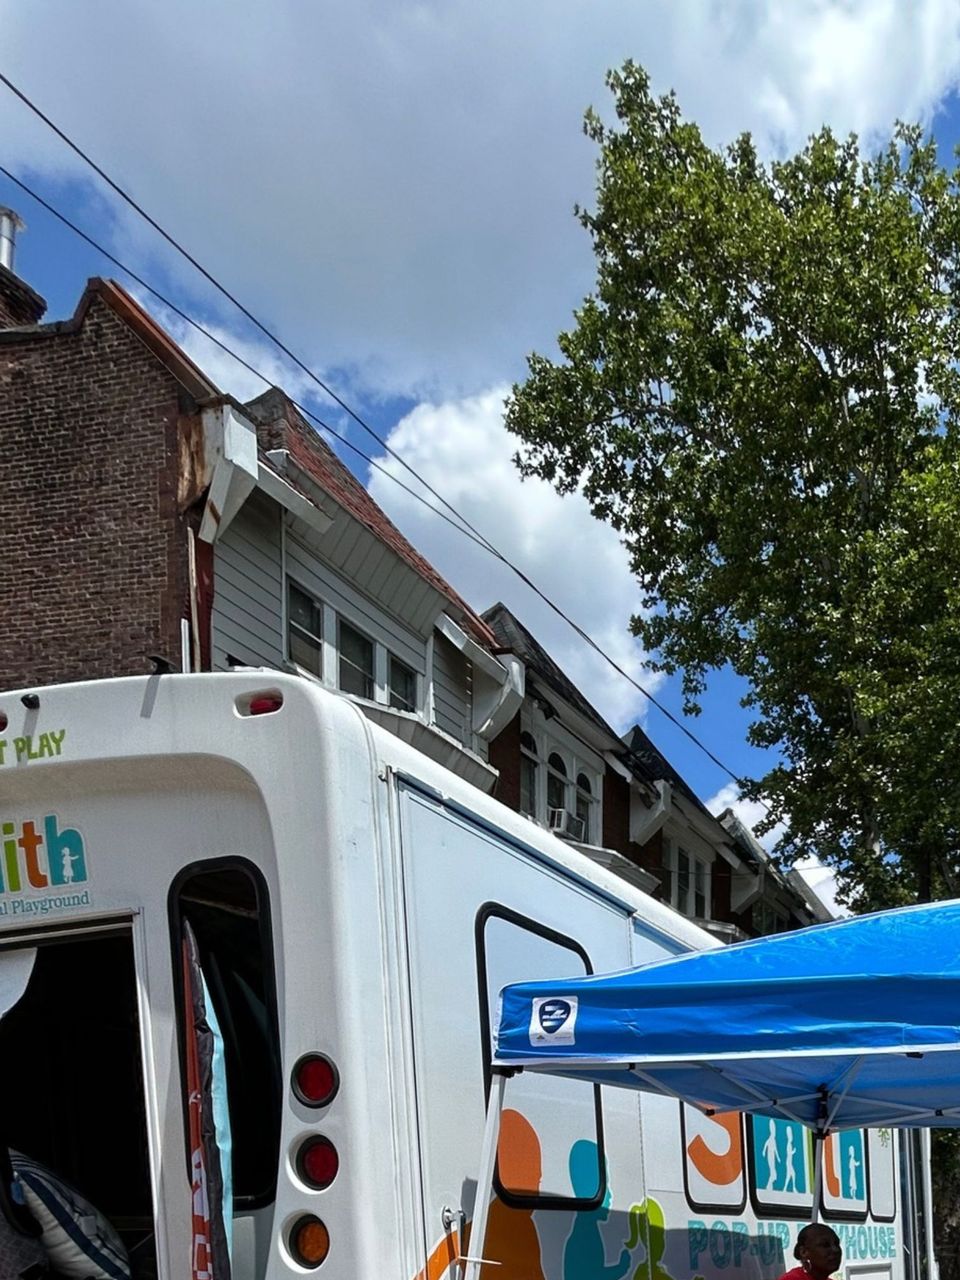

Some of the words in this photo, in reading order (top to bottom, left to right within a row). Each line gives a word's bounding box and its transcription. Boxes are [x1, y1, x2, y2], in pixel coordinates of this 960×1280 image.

[13, 729, 66, 762] PLAY
[12, 891, 90, 918] Playground
[688, 1220, 790, 1270] POP-UP
